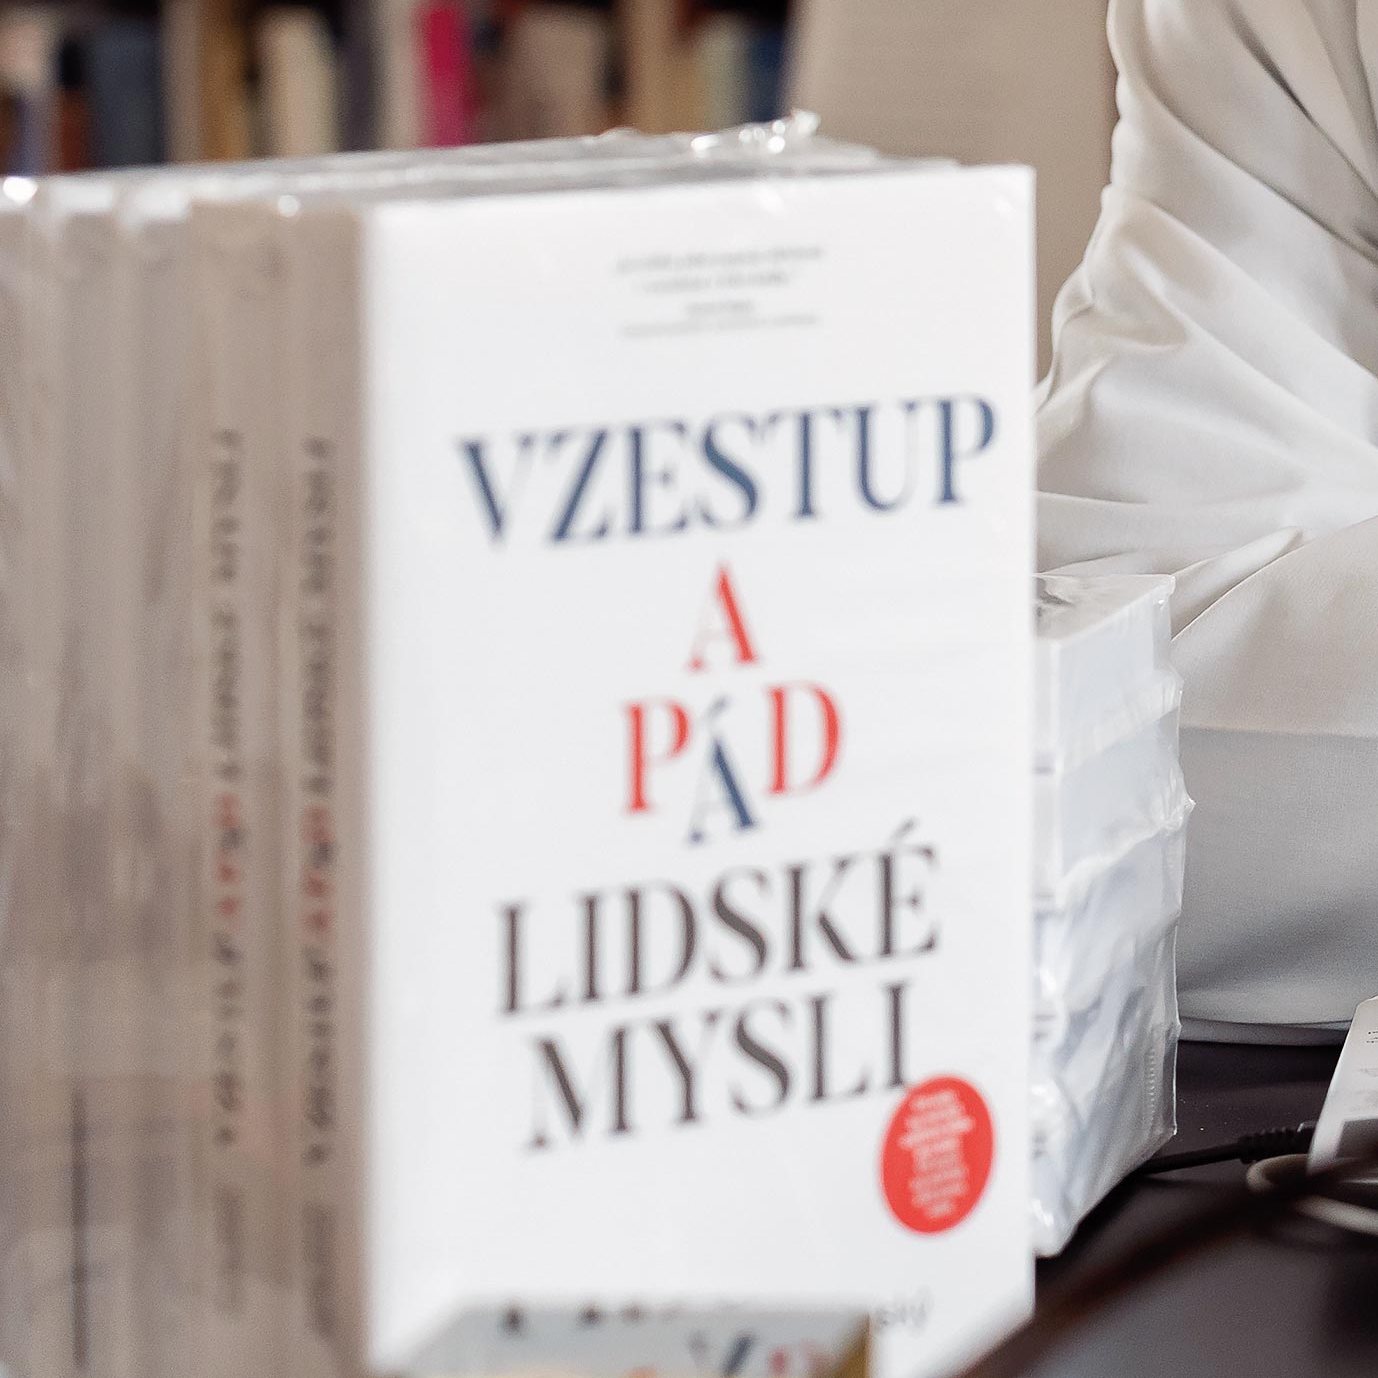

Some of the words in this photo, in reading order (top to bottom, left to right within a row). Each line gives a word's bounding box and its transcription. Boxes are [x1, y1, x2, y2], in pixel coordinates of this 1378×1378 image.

[454, 393, 999, 549] VZESTUP
[686, 561, 763, 674] A
[622, 680, 846, 847] PÁD
[495, 816, 941, 1020] LIDSKÉ
[523, 979, 917, 1152] MYSLI
